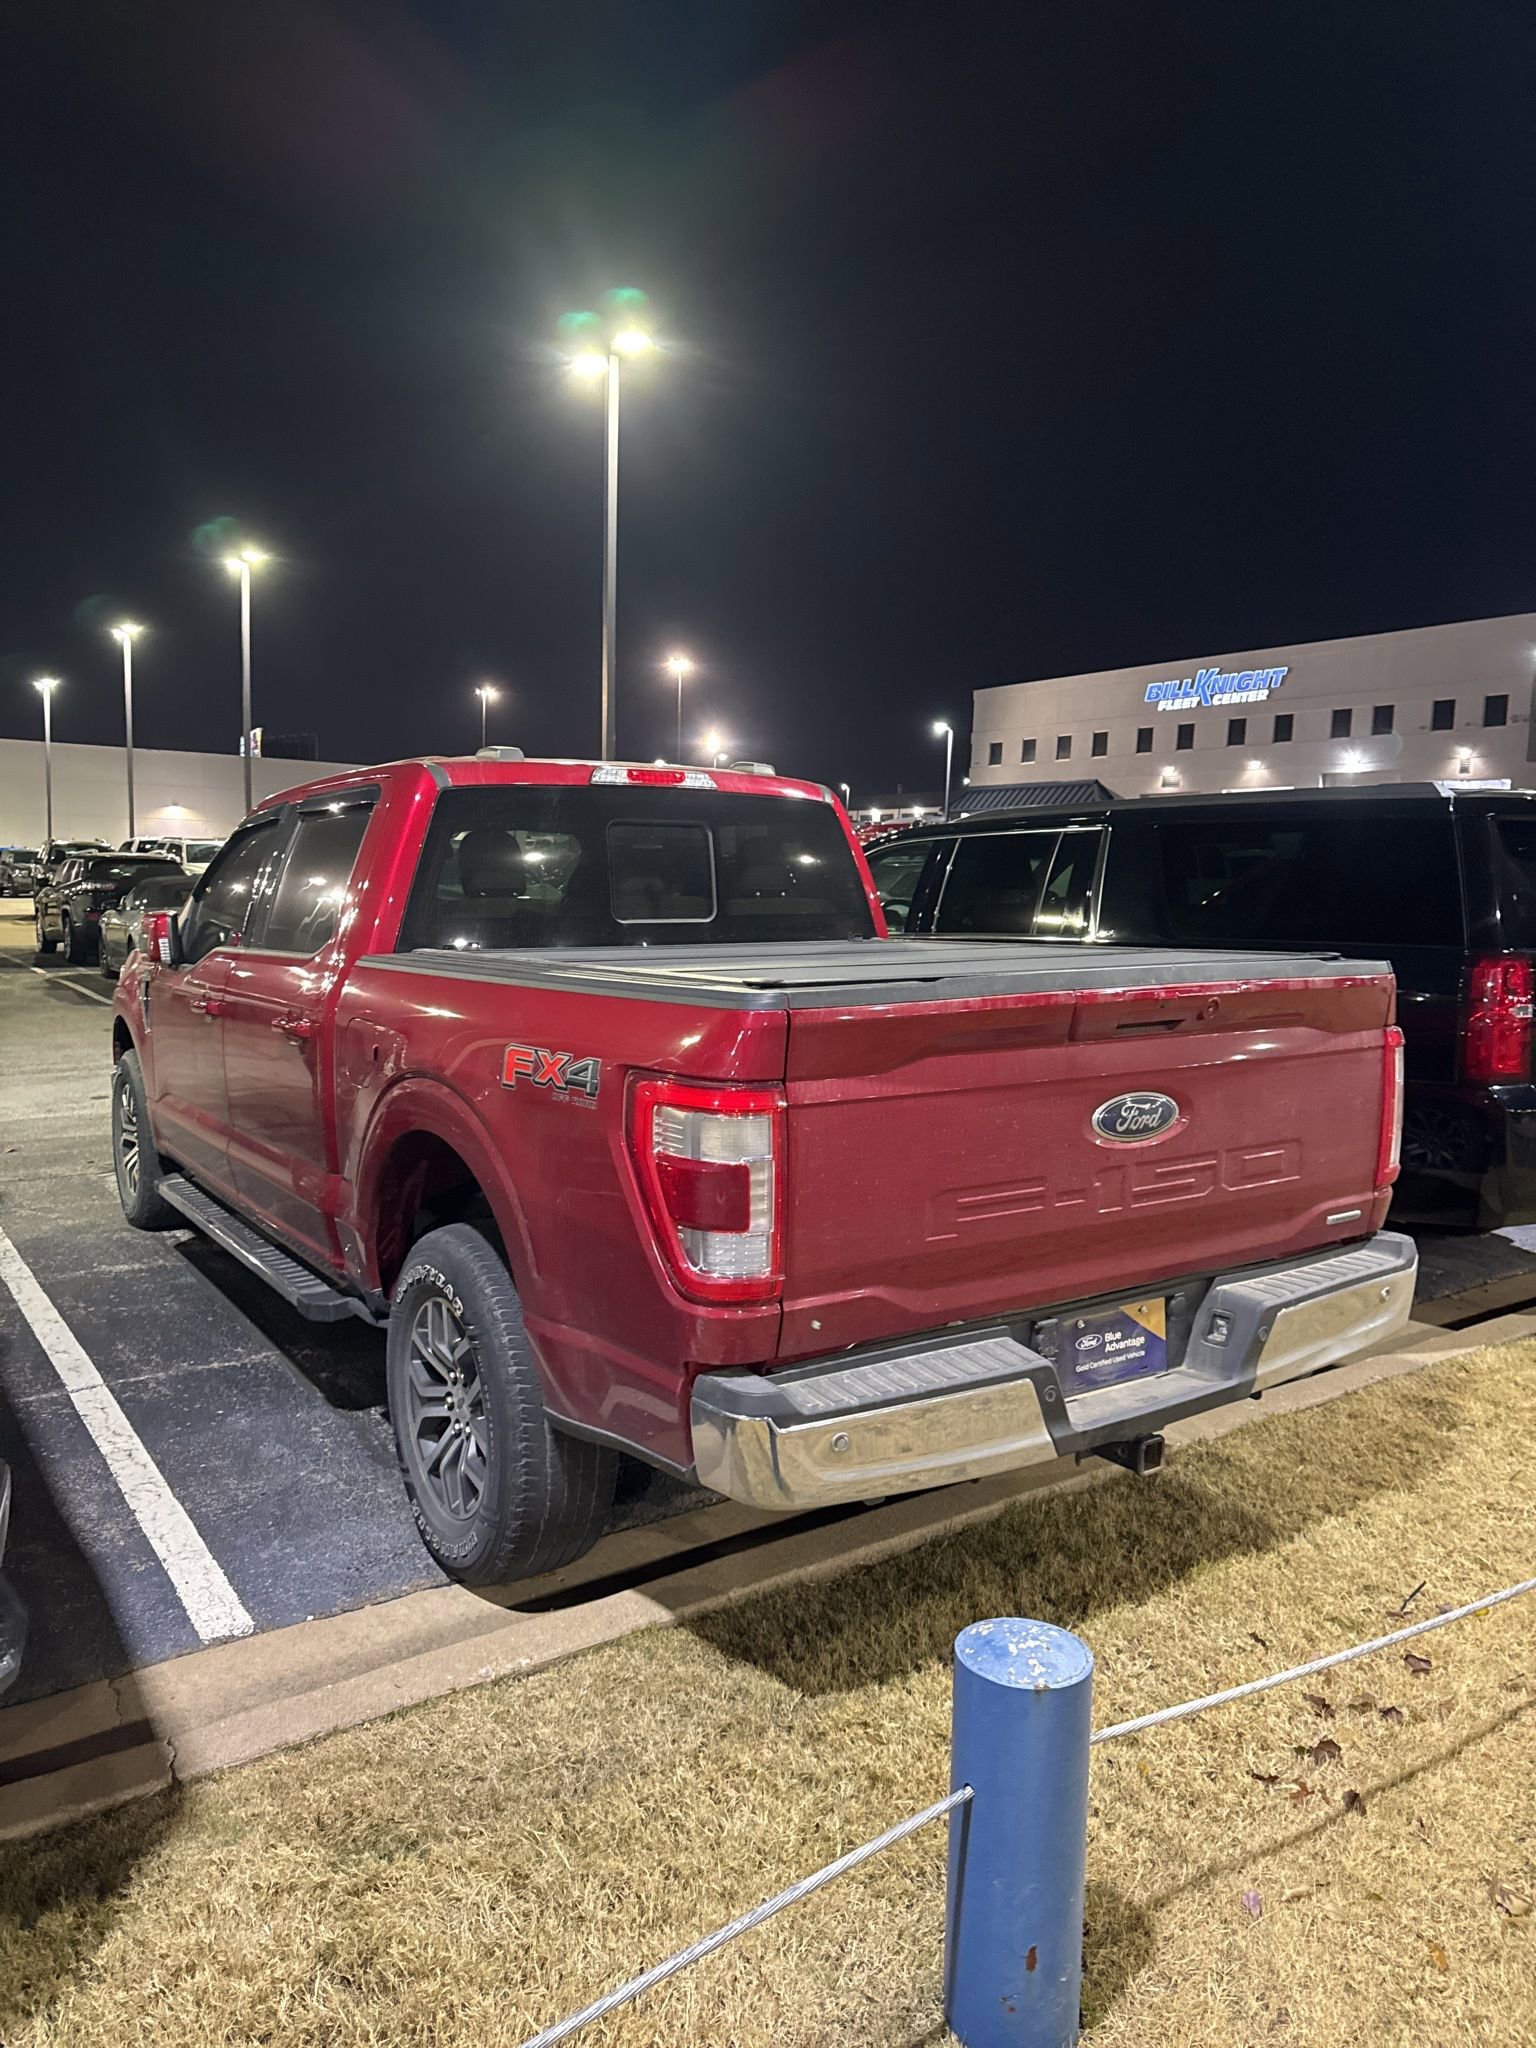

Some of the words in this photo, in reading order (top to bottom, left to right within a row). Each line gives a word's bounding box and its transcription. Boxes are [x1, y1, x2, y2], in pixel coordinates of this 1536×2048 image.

[1144, 680, 1195, 702] BILL
[1157, 697, 1200, 711] FLEET
[1212, 689, 1269, 706] CENTER
[501, 1043, 601, 1099] FX4
[1115, 1103, 1162, 1132] Ford
[926, 1139, 1301, 1241] F-150
[1104, 1332, 1121, 1342] Blue
[1104, 1336, 1145, 1353] Advantage
[1075, 1364, 1089, 1372] Gold
[1090, 1359, 1112, 1369] Certified
[1126, 1350, 1145, 1359] Vehicle
